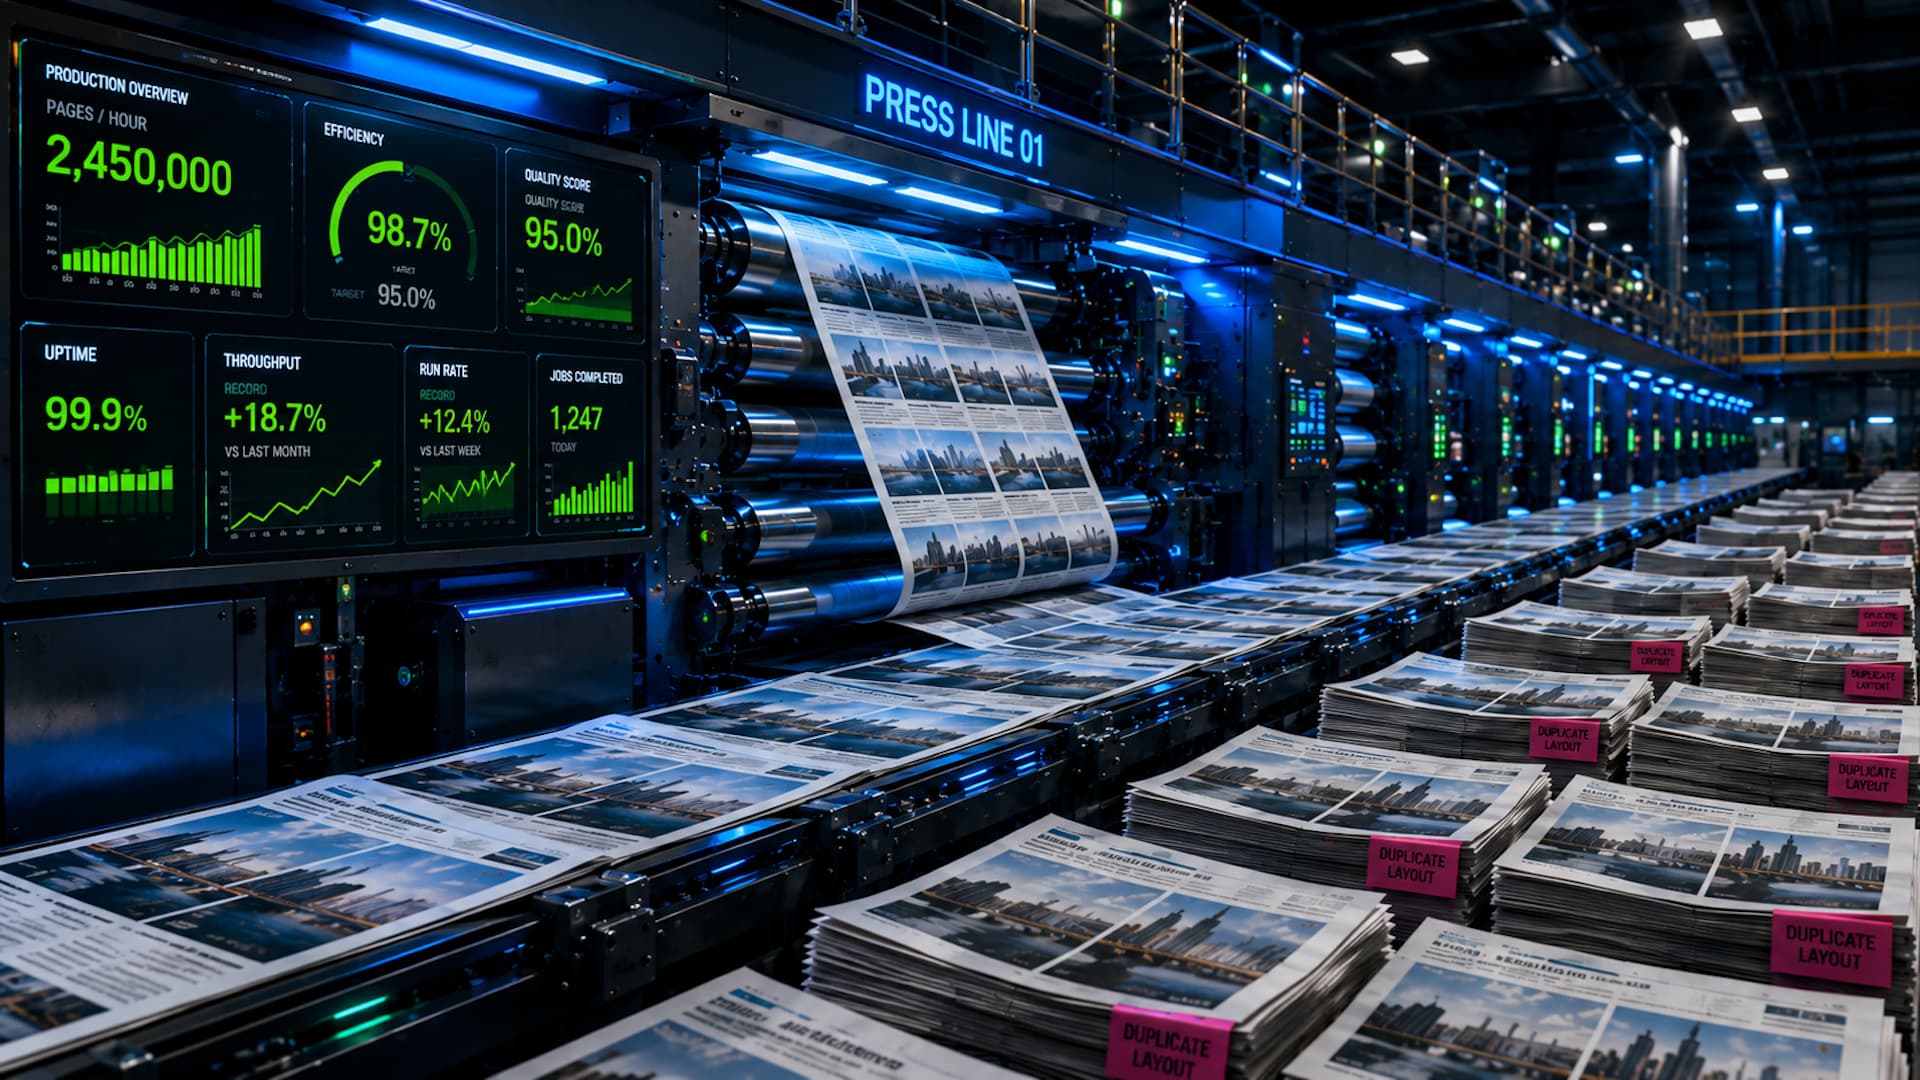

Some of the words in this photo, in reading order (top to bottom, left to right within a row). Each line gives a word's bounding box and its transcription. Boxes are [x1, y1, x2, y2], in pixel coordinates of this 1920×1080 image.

[46, 64, 126, 94] PRODUCTION
[129, 81, 189, 105] OVERVIEW
[46, 98, 94, 122] PAGES
[109, 110, 148, 131] HOUR
[865, 73, 954, 138] PRESS
[962, 107, 1014, 158] LINE
[1020, 129, 1043, 167] 01
[324, 122, 385, 147] EFFICIENCY
[46, 133, 232, 196] 2,450,000
[525, 168, 561, 186] QUALITY
[563, 175, 591, 192] SCORE
[525, 194, 559, 209] QUALITY
[367, 210, 452, 252] 98.7%
[525, 216, 602, 256] 95.0%
[378, 283, 436, 310] 95.0%
[44, 344, 97, 362] UPTIME
[224, 352, 302, 370] THROUGHPUT
[419, 362, 441, 376] RUN
[443, 364, 468, 378] RATE
[550, 370, 573, 382] JOBS
[575, 370, 624, 384] COMPLETED
[224, 382, 268, 396] RECORD
[420, 389, 456, 401] RECORD
[45, 396, 147, 432] 99.9%
[224, 401, 326, 432] +18.7%
[420, 408, 490, 434] +12.4%
[550, 405, 603, 434] 1,247
[225, 446, 240, 458] VS
[242, 446, 270, 458] LAST
[272, 445, 311, 458] MONTH
[420, 446, 432, 456] VS
[434, 446, 456, 456] LAST
[458, 445, 482, 456] WEEK
[551, 442, 578, 452] TODAY
[1538, 726, 1589, 740] DUPLICATE
[1544, 740, 1581, 752] LAYOUT
[1838, 763, 1896, 780] DUPLICATE
[1380, 847, 1446, 868] DUPLICATE
[1387, 866, 1436, 884] LAYOUT
[1786, 924, 1876, 950] DUPLICATE
[1799, 947, 1862, 970] LAYOUT
[1123, 1022, 1211, 1058] DUPLICATE
[1132, 1048, 1196, 1080] LAYOUT
